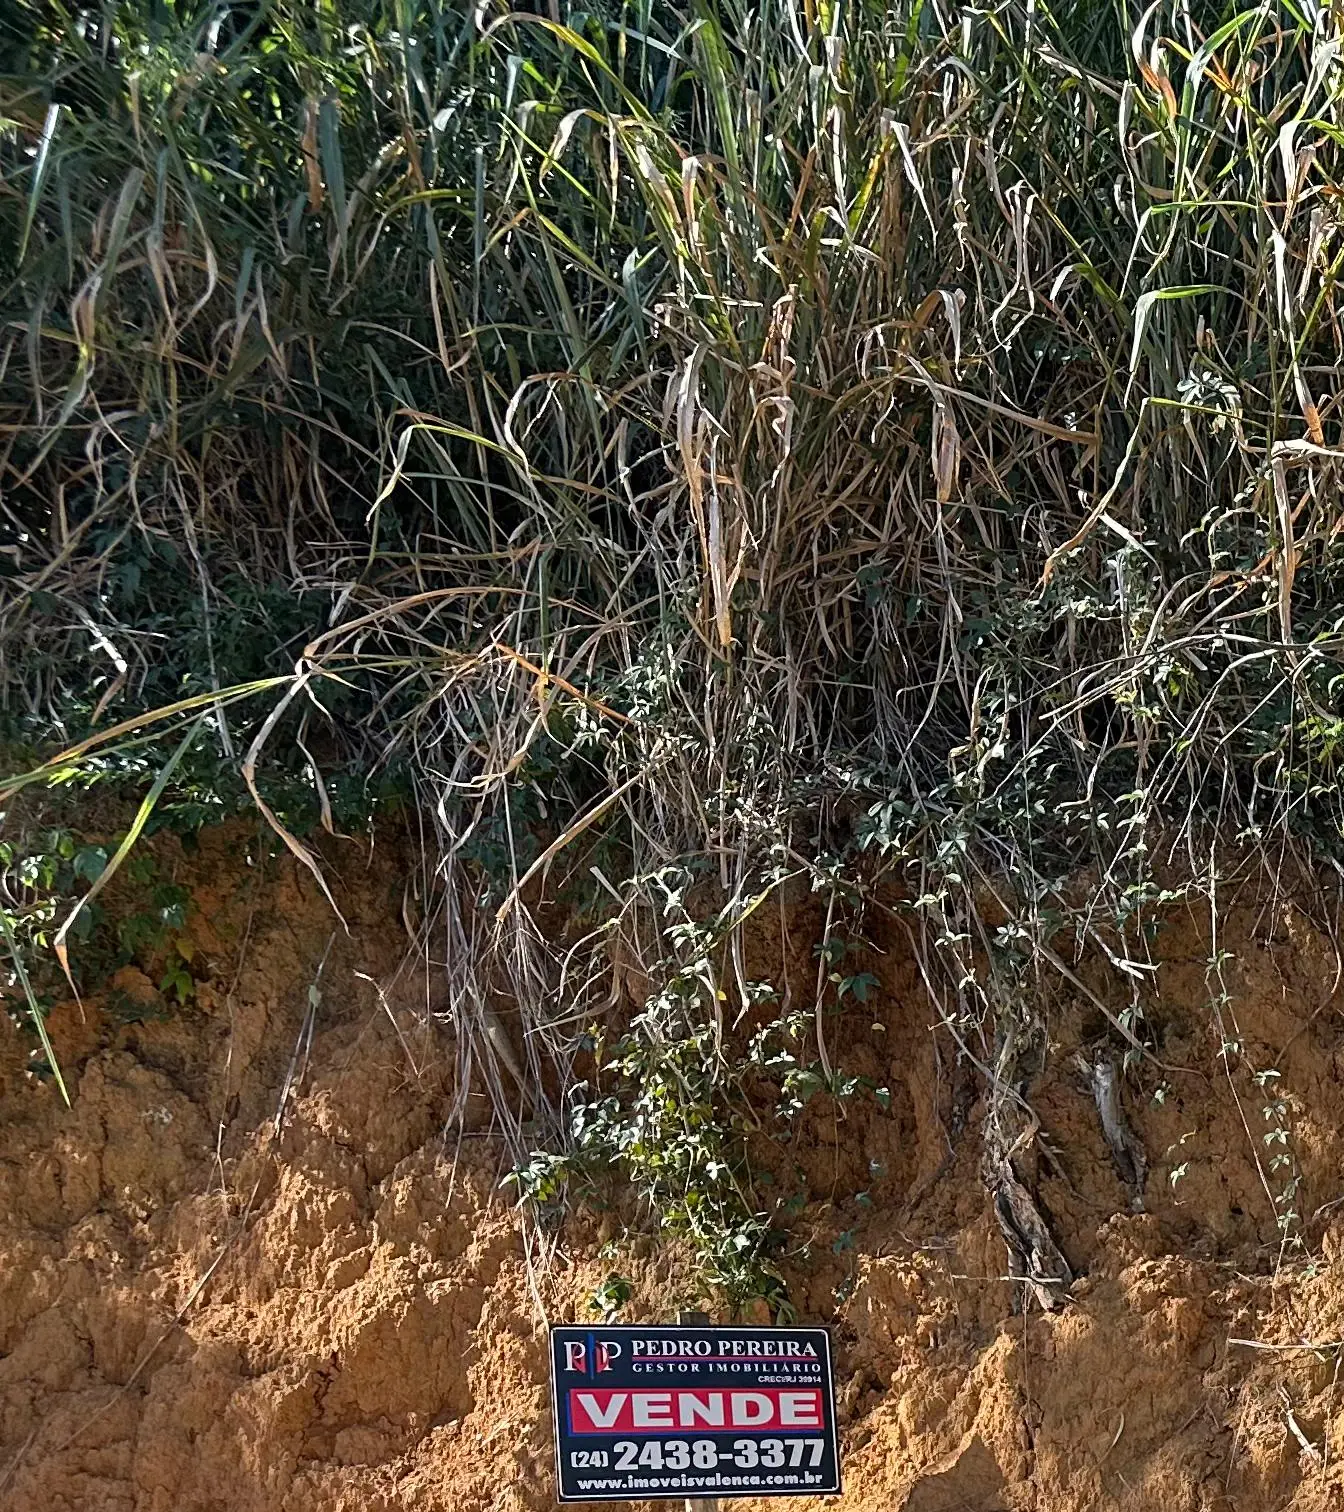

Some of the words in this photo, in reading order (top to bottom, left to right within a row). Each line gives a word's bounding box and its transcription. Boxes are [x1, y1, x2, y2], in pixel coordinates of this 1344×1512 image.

[632, 1340, 712, 1357] PEDRO
[718, 1341, 818, 1357] PEREIRA
[632, 1363, 701, 1373] GESTOR
[577, 1392, 820, 1428] VENDE
[570, 1451, 609, 1468] (24)
[613, 1438, 825, 1471] 2438-3377
[577, 1471, 823, 1490] www.imoveisvalenca.com.br
